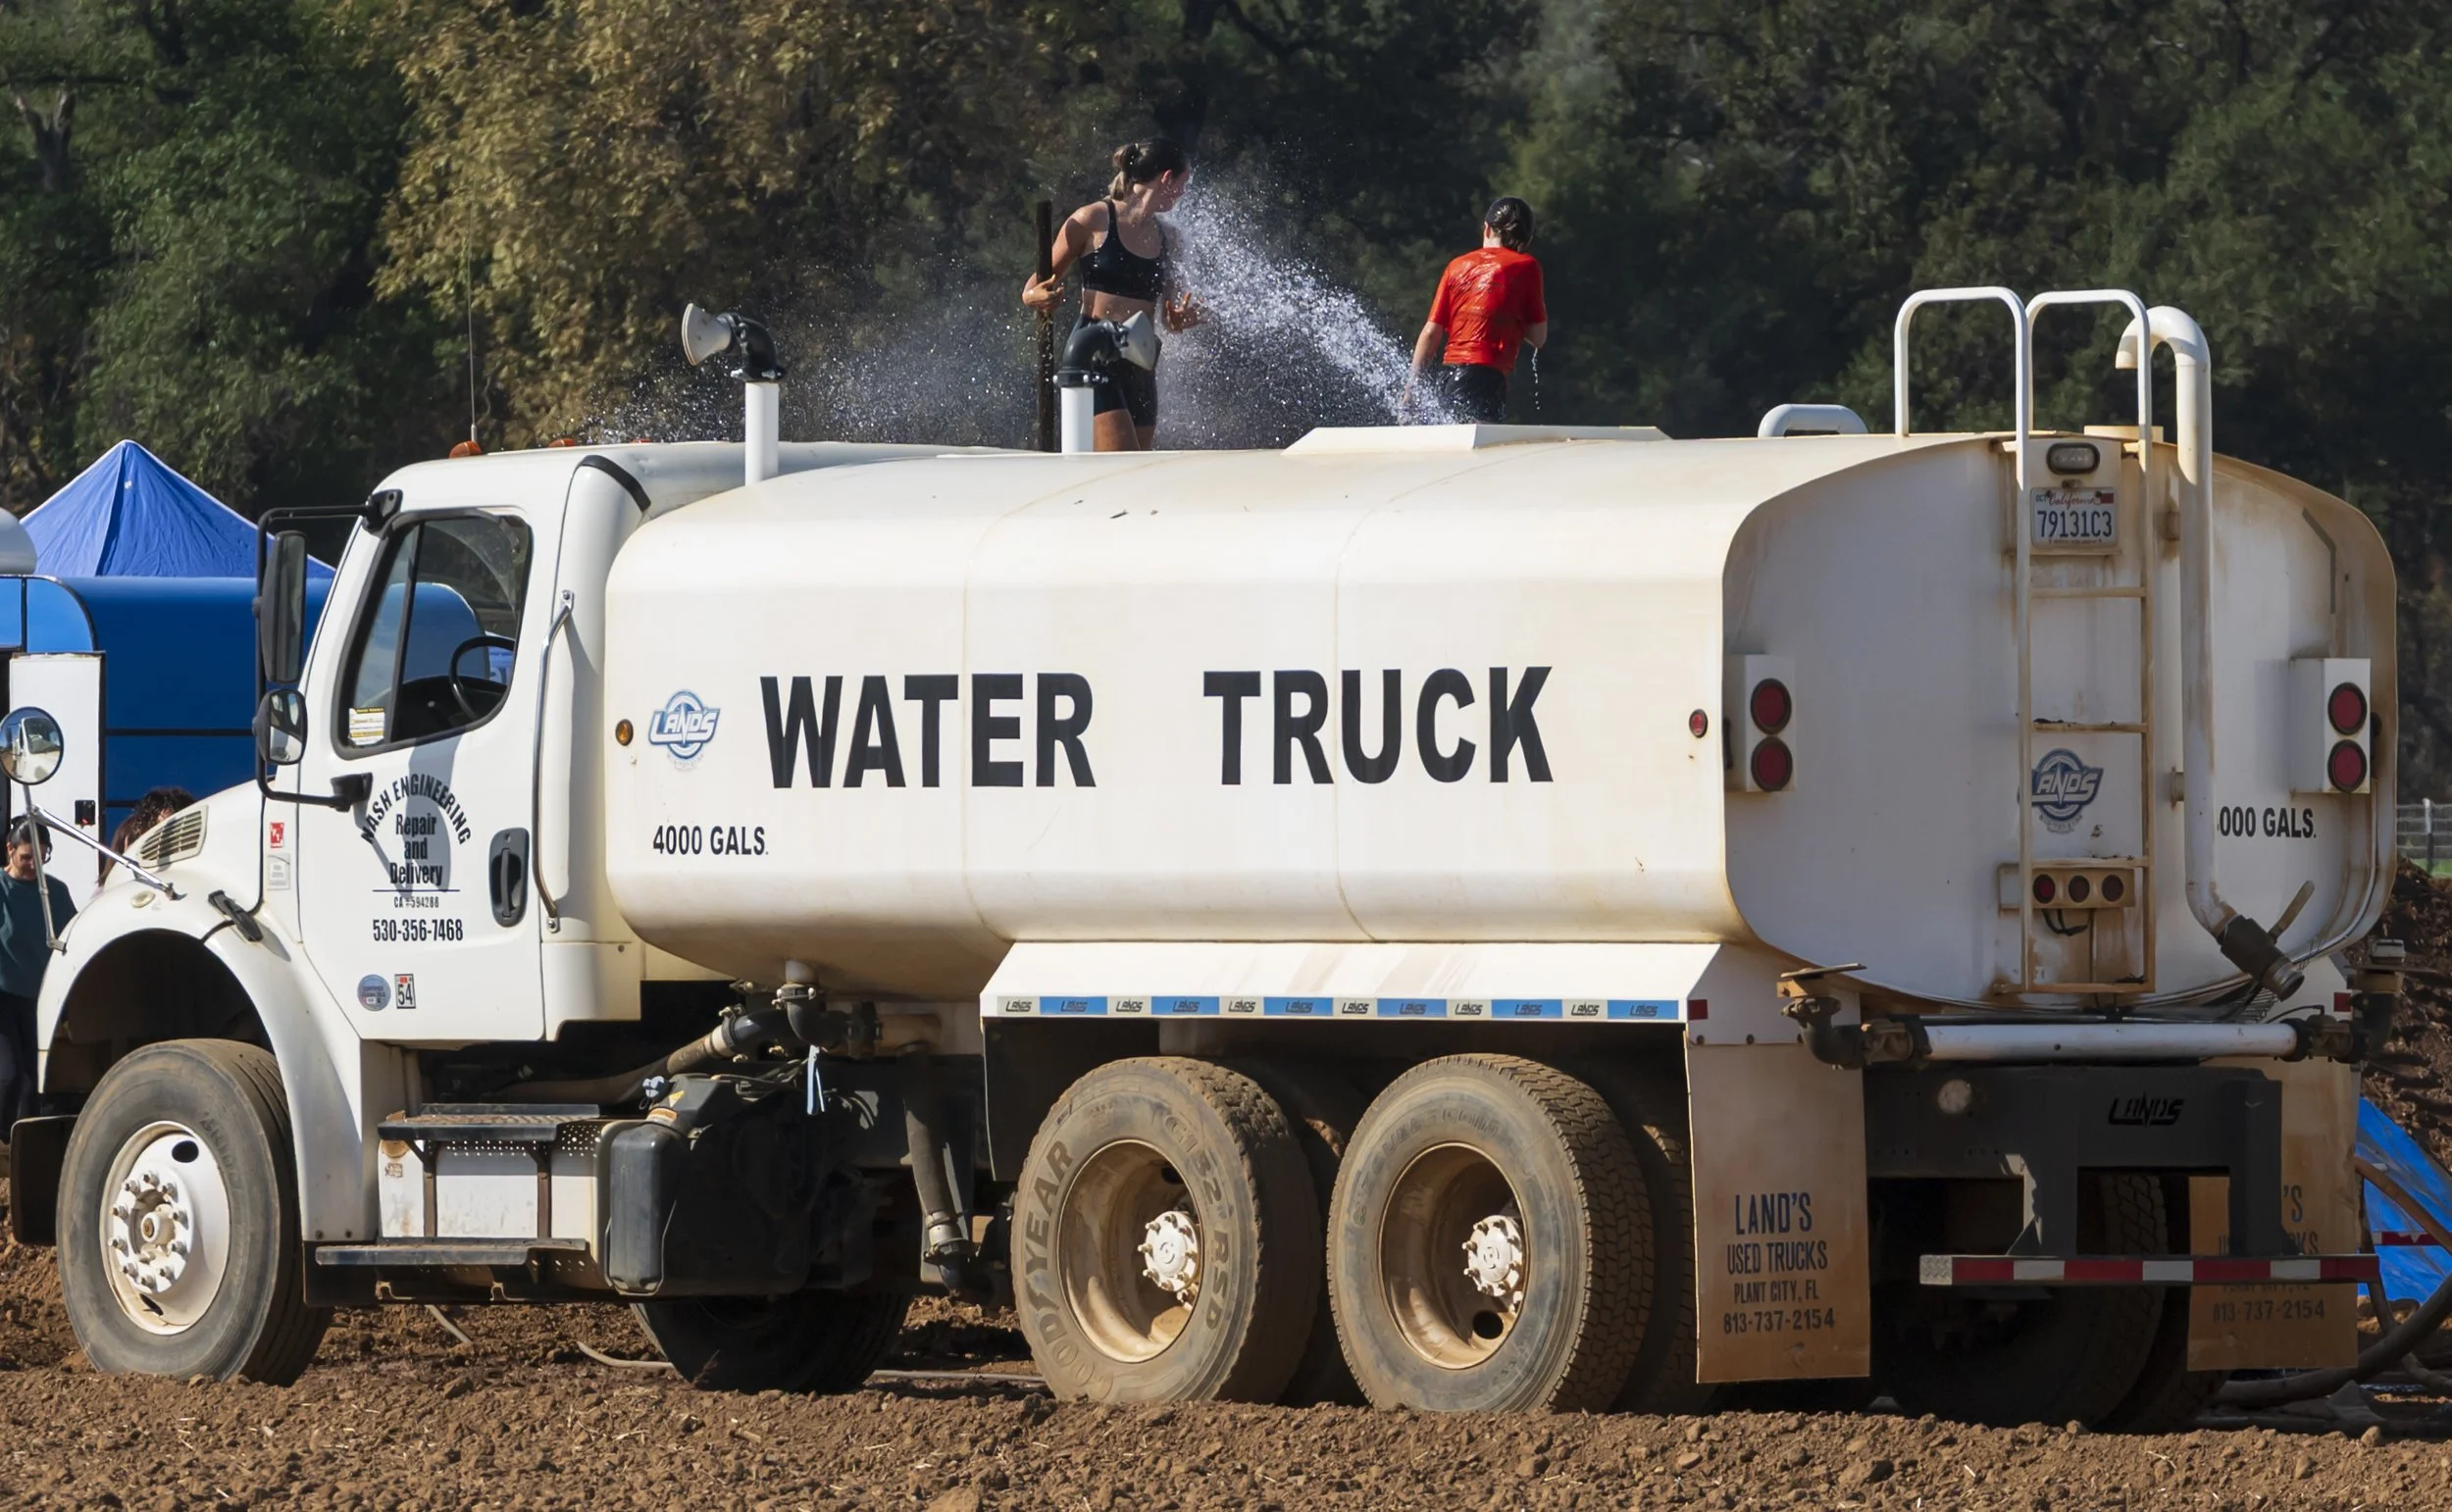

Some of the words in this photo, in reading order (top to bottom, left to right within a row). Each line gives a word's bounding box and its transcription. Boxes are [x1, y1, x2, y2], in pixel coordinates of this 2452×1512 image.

[2048, 490, 2096, 510] California
[2037, 510, 2113, 538] 79131C3
[760, 673, 1097, 788] WATER
[1203, 666, 1554, 785] TRUCK
[361, 789, 392, 844] NASH
[392, 773, 471, 845] ENGINEERING
[2217, 806, 2256, 837] 000
[2263, 807, 2317, 838] GALS.
[395, 813, 437, 835] Repair
[404, 837, 428, 860] and
[652, 825, 702, 855] 4000
[710, 825, 769, 856] GALS.
[390, 862, 442, 886] Delivery
[394, 896, 404, 908] CA
[373, 919, 463, 941] 530-356-7468
[398, 983, 413, 1005] 54
[1735, 1192, 1813, 1235] LAND'S
[1727, 1242, 1762, 1275] USED
[1766, 1239, 1828, 1273] TRUCKS
[1205, 1229, 1230, 1331] RSD
[1734, 1282, 1766, 1304] PLANT
[1770, 1280, 1803, 1303] CITY,
[1723, 1307, 1836, 1335] 813-737-2154
[2213, 1298, 2325, 1323] 813-737-2154
